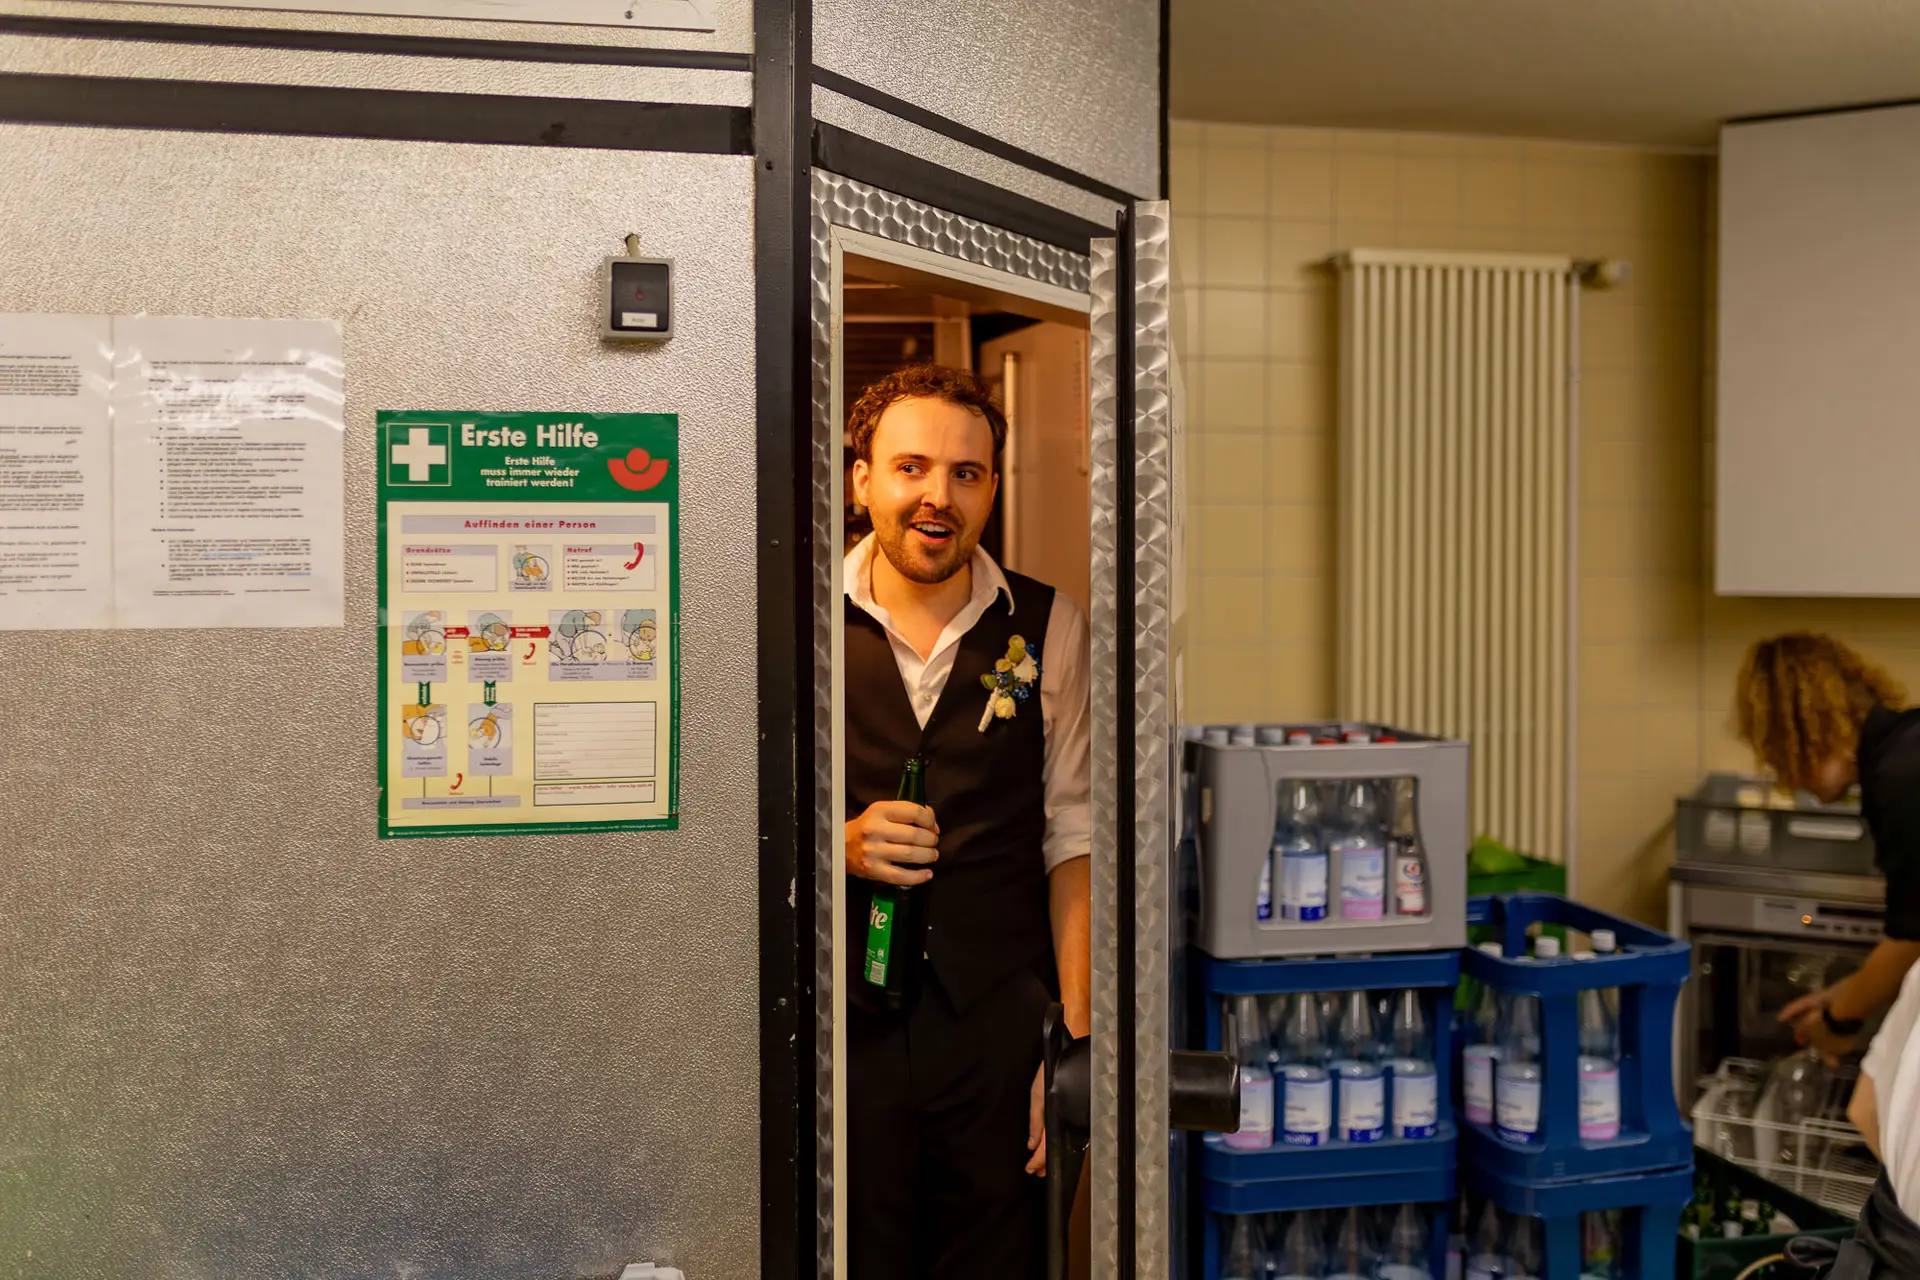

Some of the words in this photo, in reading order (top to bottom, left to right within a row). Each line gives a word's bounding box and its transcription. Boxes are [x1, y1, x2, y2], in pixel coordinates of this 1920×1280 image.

[461, 423, 527, 448] Erste
[536, 423, 599, 448] Hilfe
[504, 456, 530, 466] Erste
[531, 456, 556, 466] Hilfe
[480, 468, 507, 477] muss
[509, 467, 542, 477] immer
[544, 467, 580, 477] wieder
[486, 478, 528, 487] trainiert
[530, 478, 575, 488] werden!
[464, 520, 520, 529] Auffinden
[524, 520, 554, 529] einer
[558, 520, 597, 529] Person
